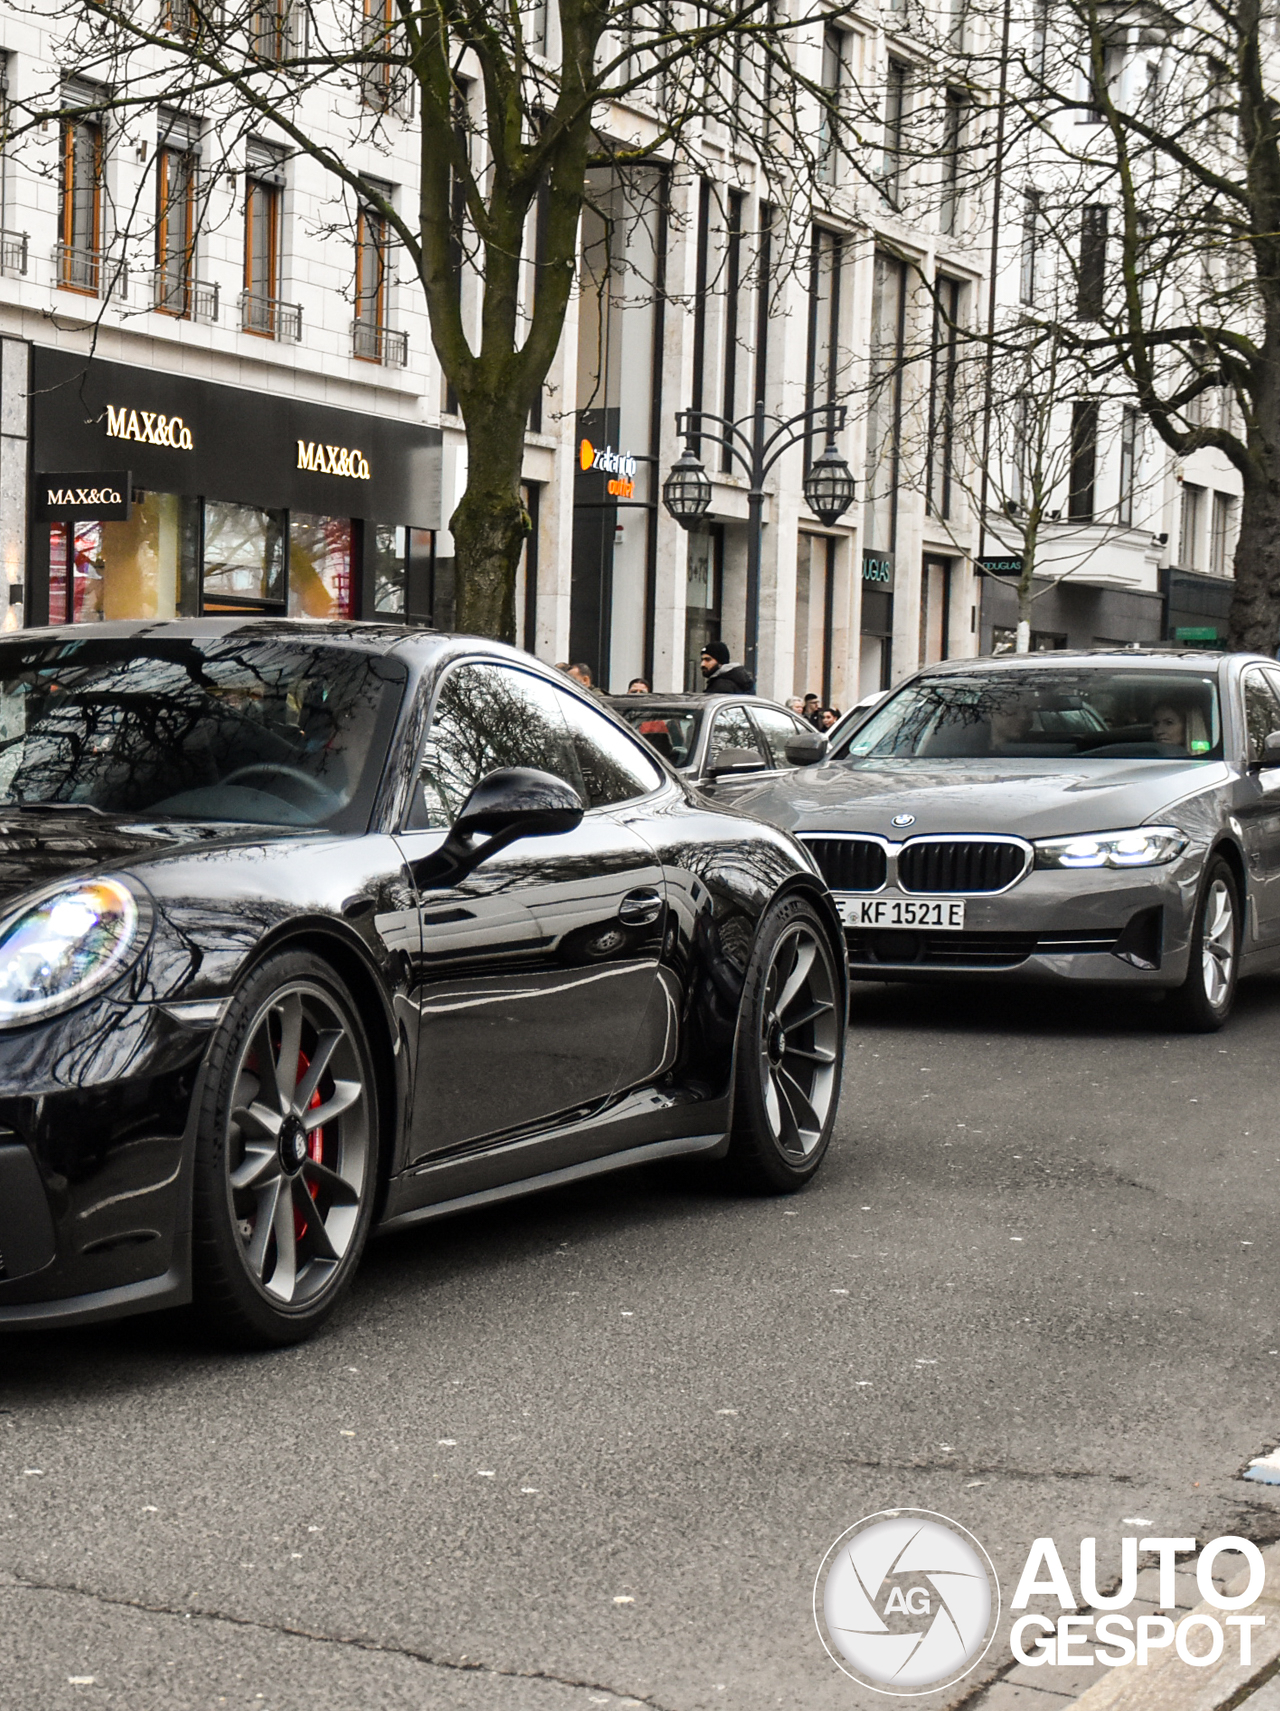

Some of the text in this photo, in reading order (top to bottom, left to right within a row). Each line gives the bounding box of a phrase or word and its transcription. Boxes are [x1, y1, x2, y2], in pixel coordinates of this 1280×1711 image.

[106, 404, 194, 450] MAX&Co.
[296, 439, 371, 480] MAX&Co.
[47, 487, 122, 505] MAX&Co.
[607, 477, 636, 499] outlet
[862, 558, 890, 583] UGLAS
[861, 902, 887, 923] KF
